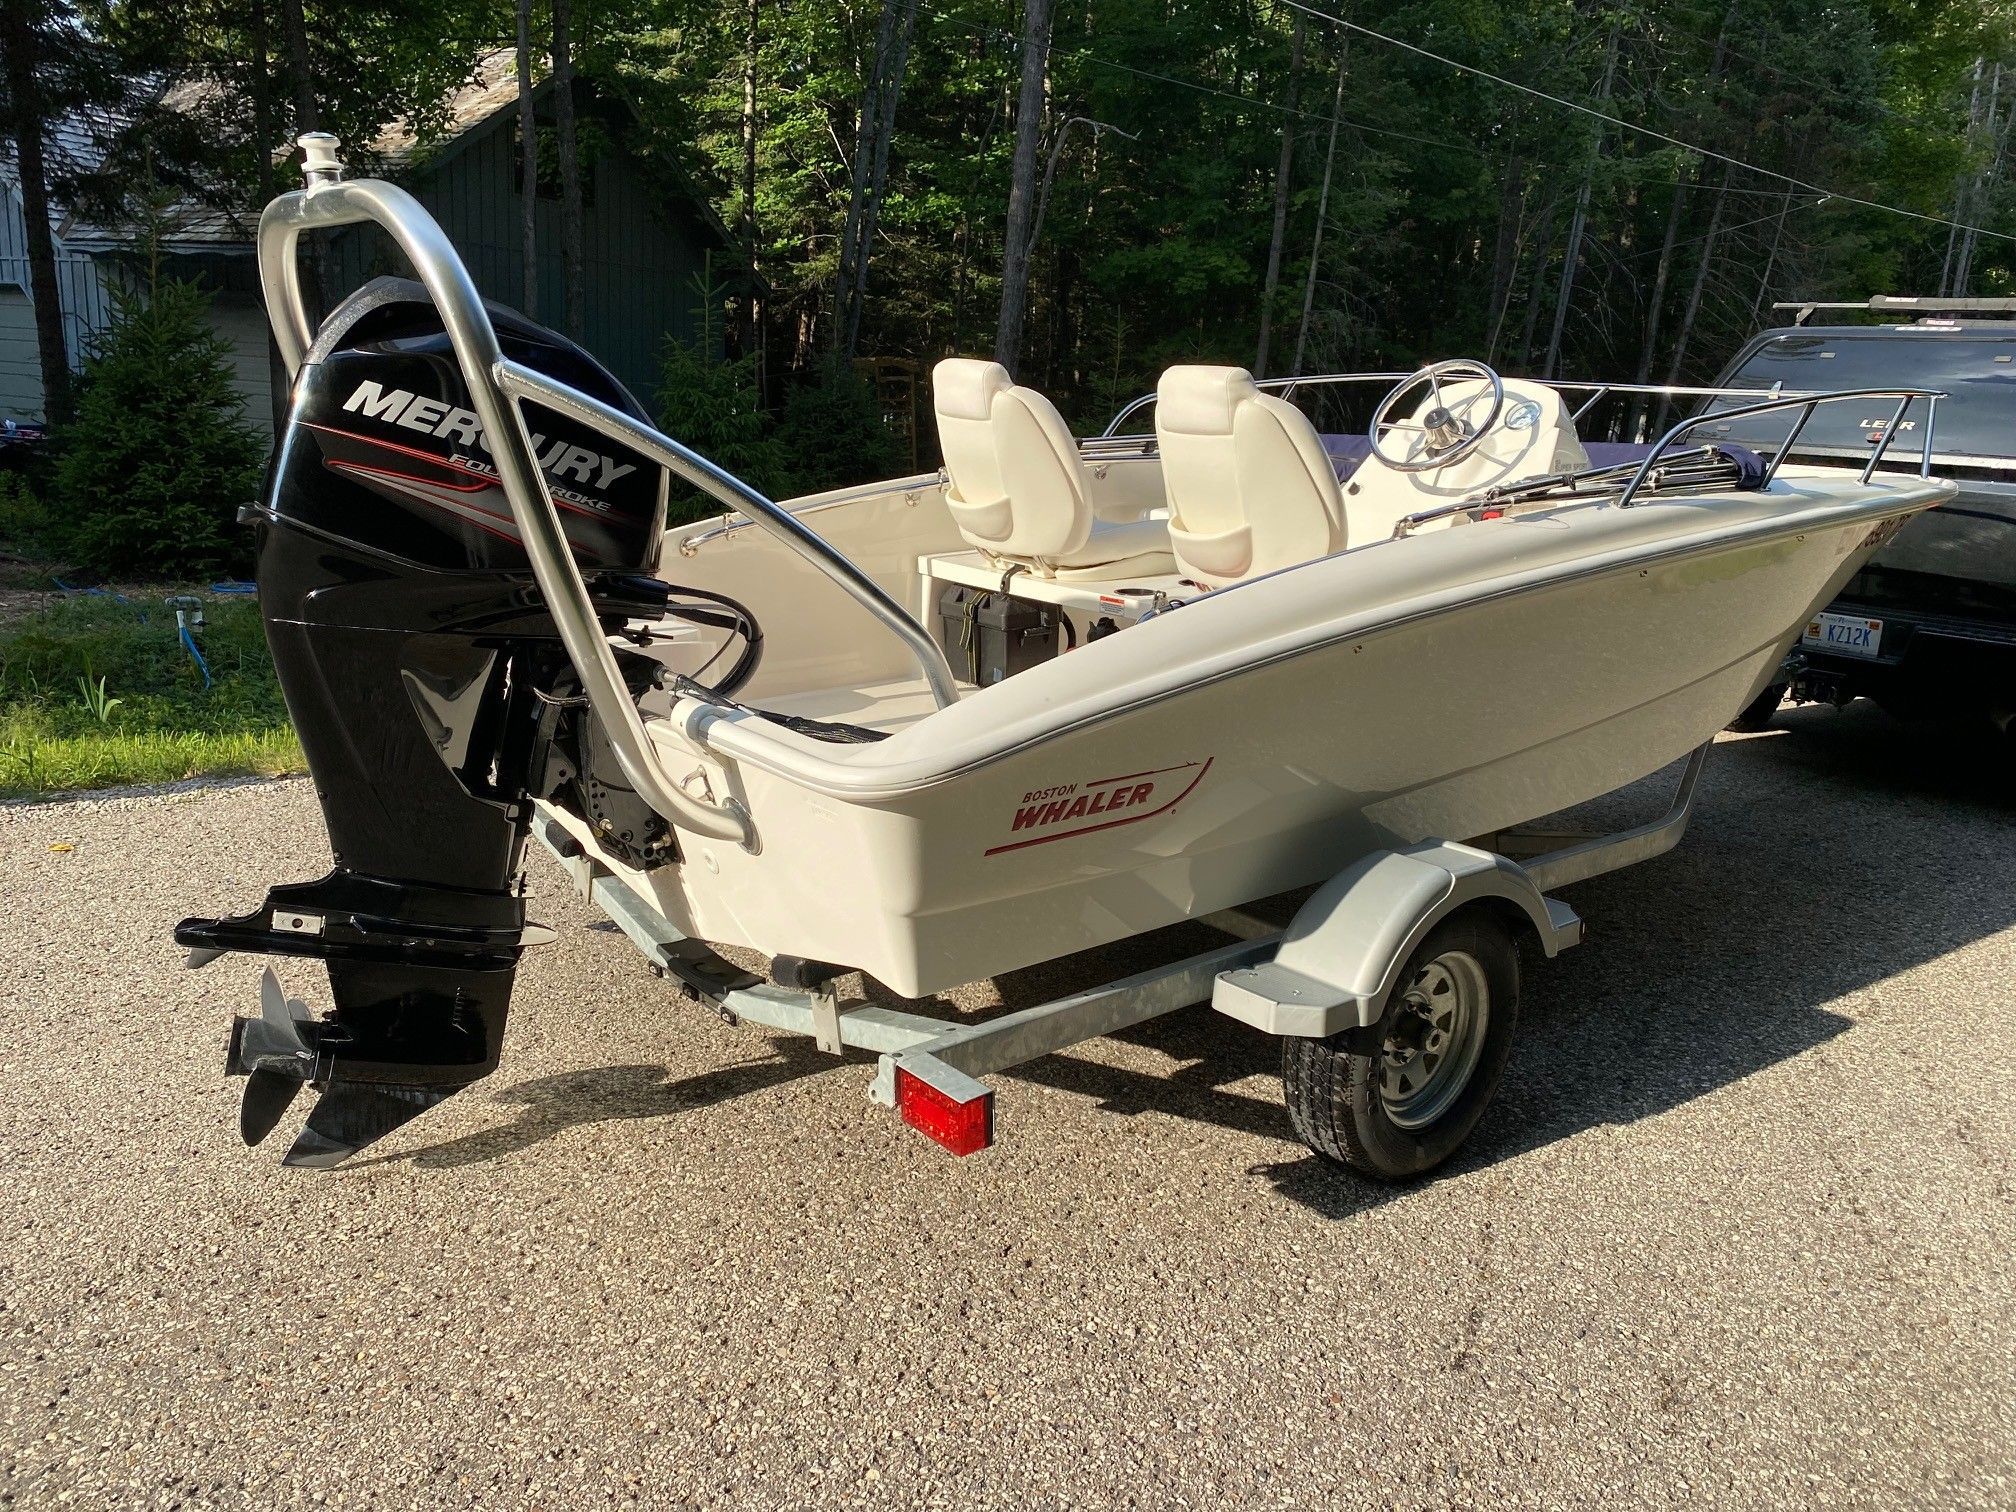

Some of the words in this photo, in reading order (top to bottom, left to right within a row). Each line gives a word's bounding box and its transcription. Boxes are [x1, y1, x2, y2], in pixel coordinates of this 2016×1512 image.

[1828, 624, 1872, 647] KZ12K
[1022, 783, 1078, 803] BOSTON
[1011, 782, 1155, 832] WHALER
